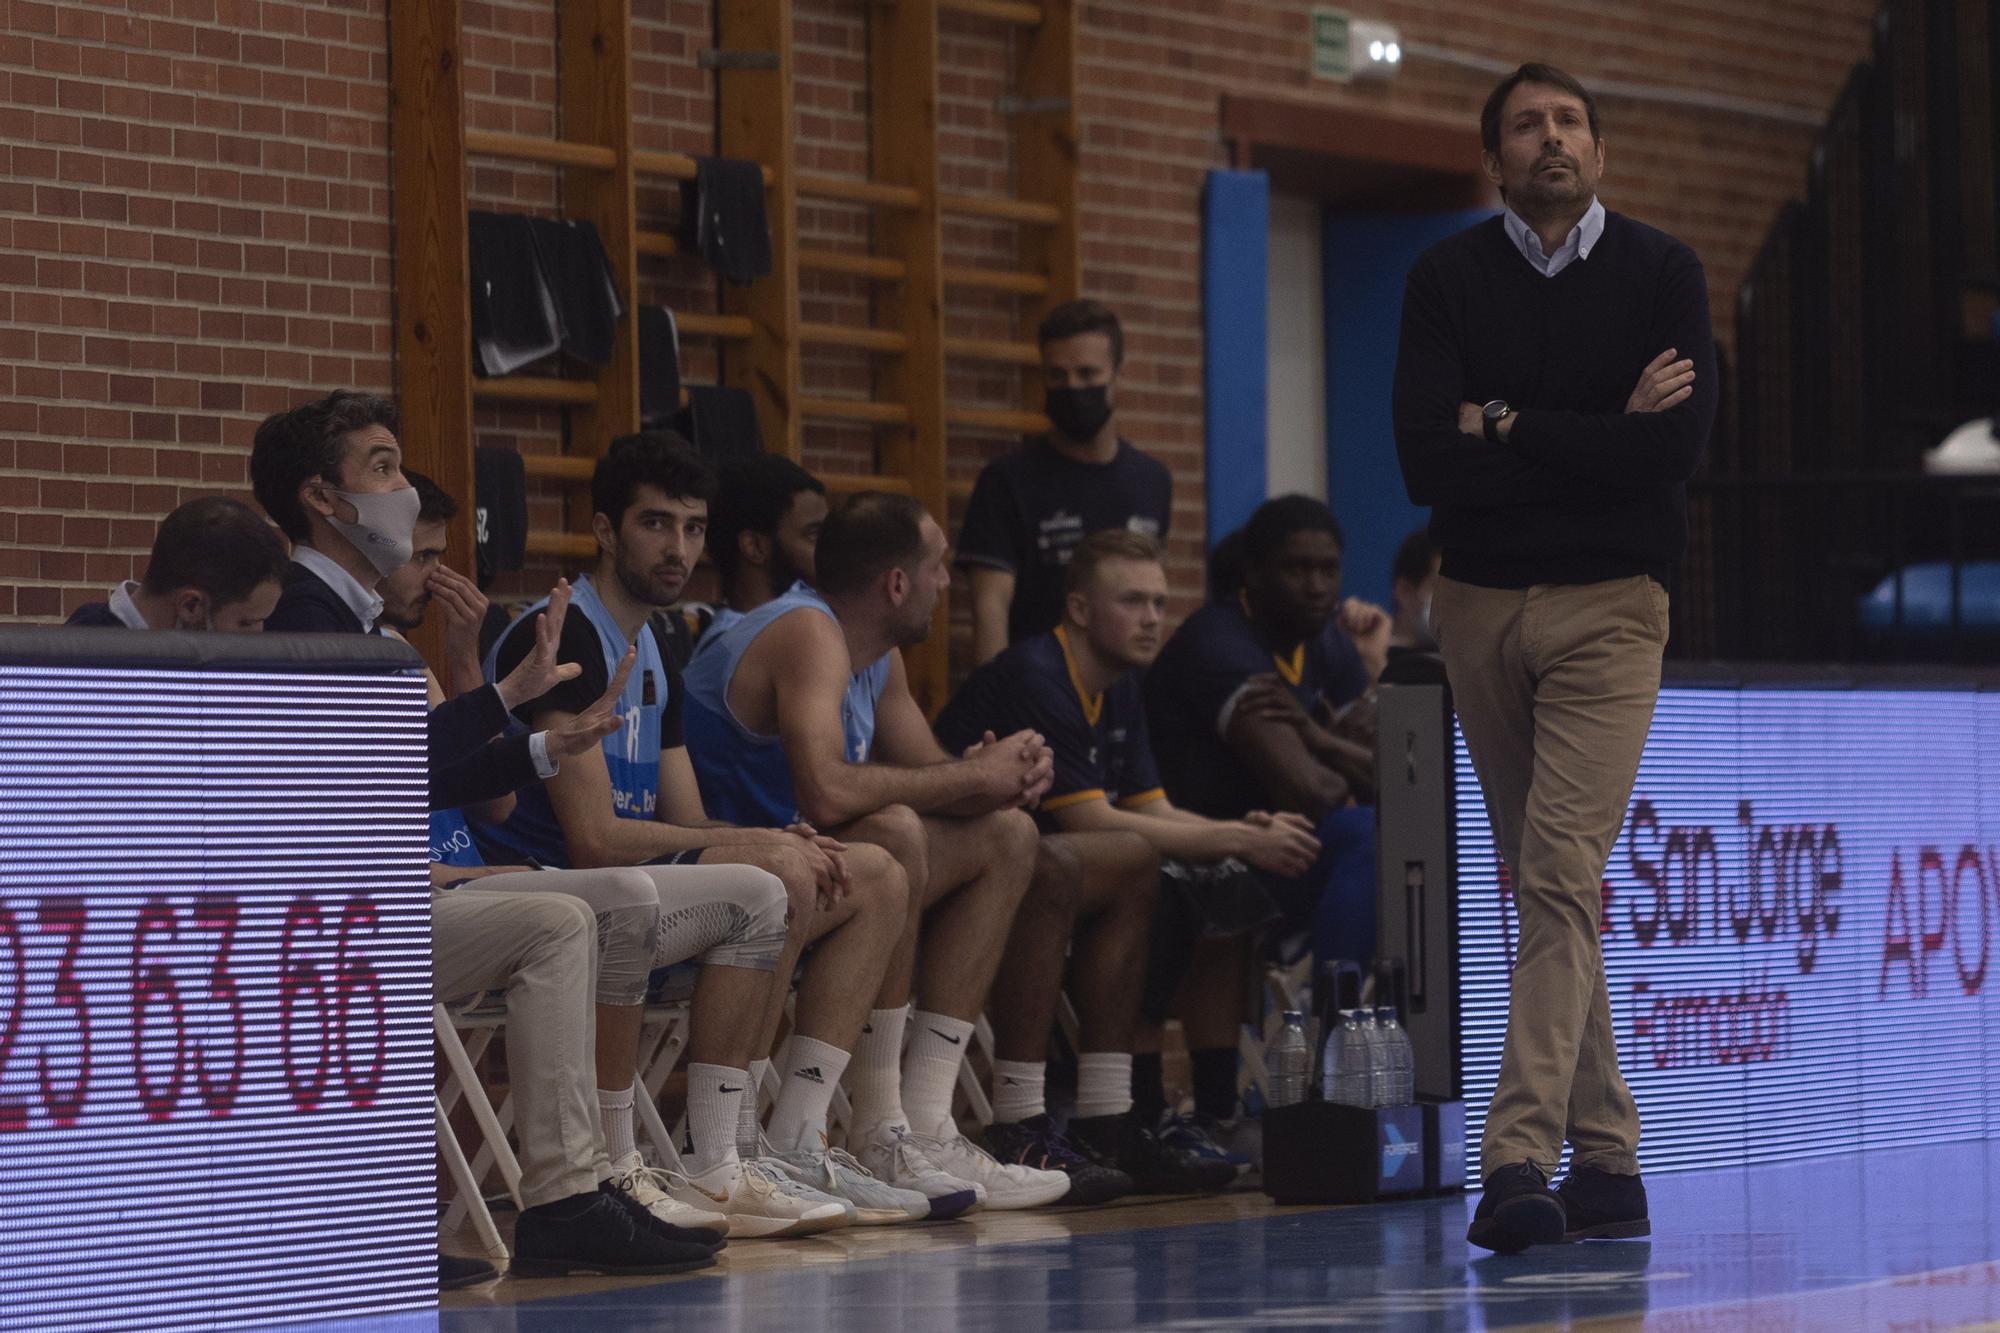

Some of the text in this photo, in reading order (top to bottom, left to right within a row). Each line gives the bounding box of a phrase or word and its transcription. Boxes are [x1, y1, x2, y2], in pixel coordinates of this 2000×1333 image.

[1629, 795, 1842, 975] San Jorge
[129, 895, 247, 1126] 63
[278, 891, 390, 1115] 66
